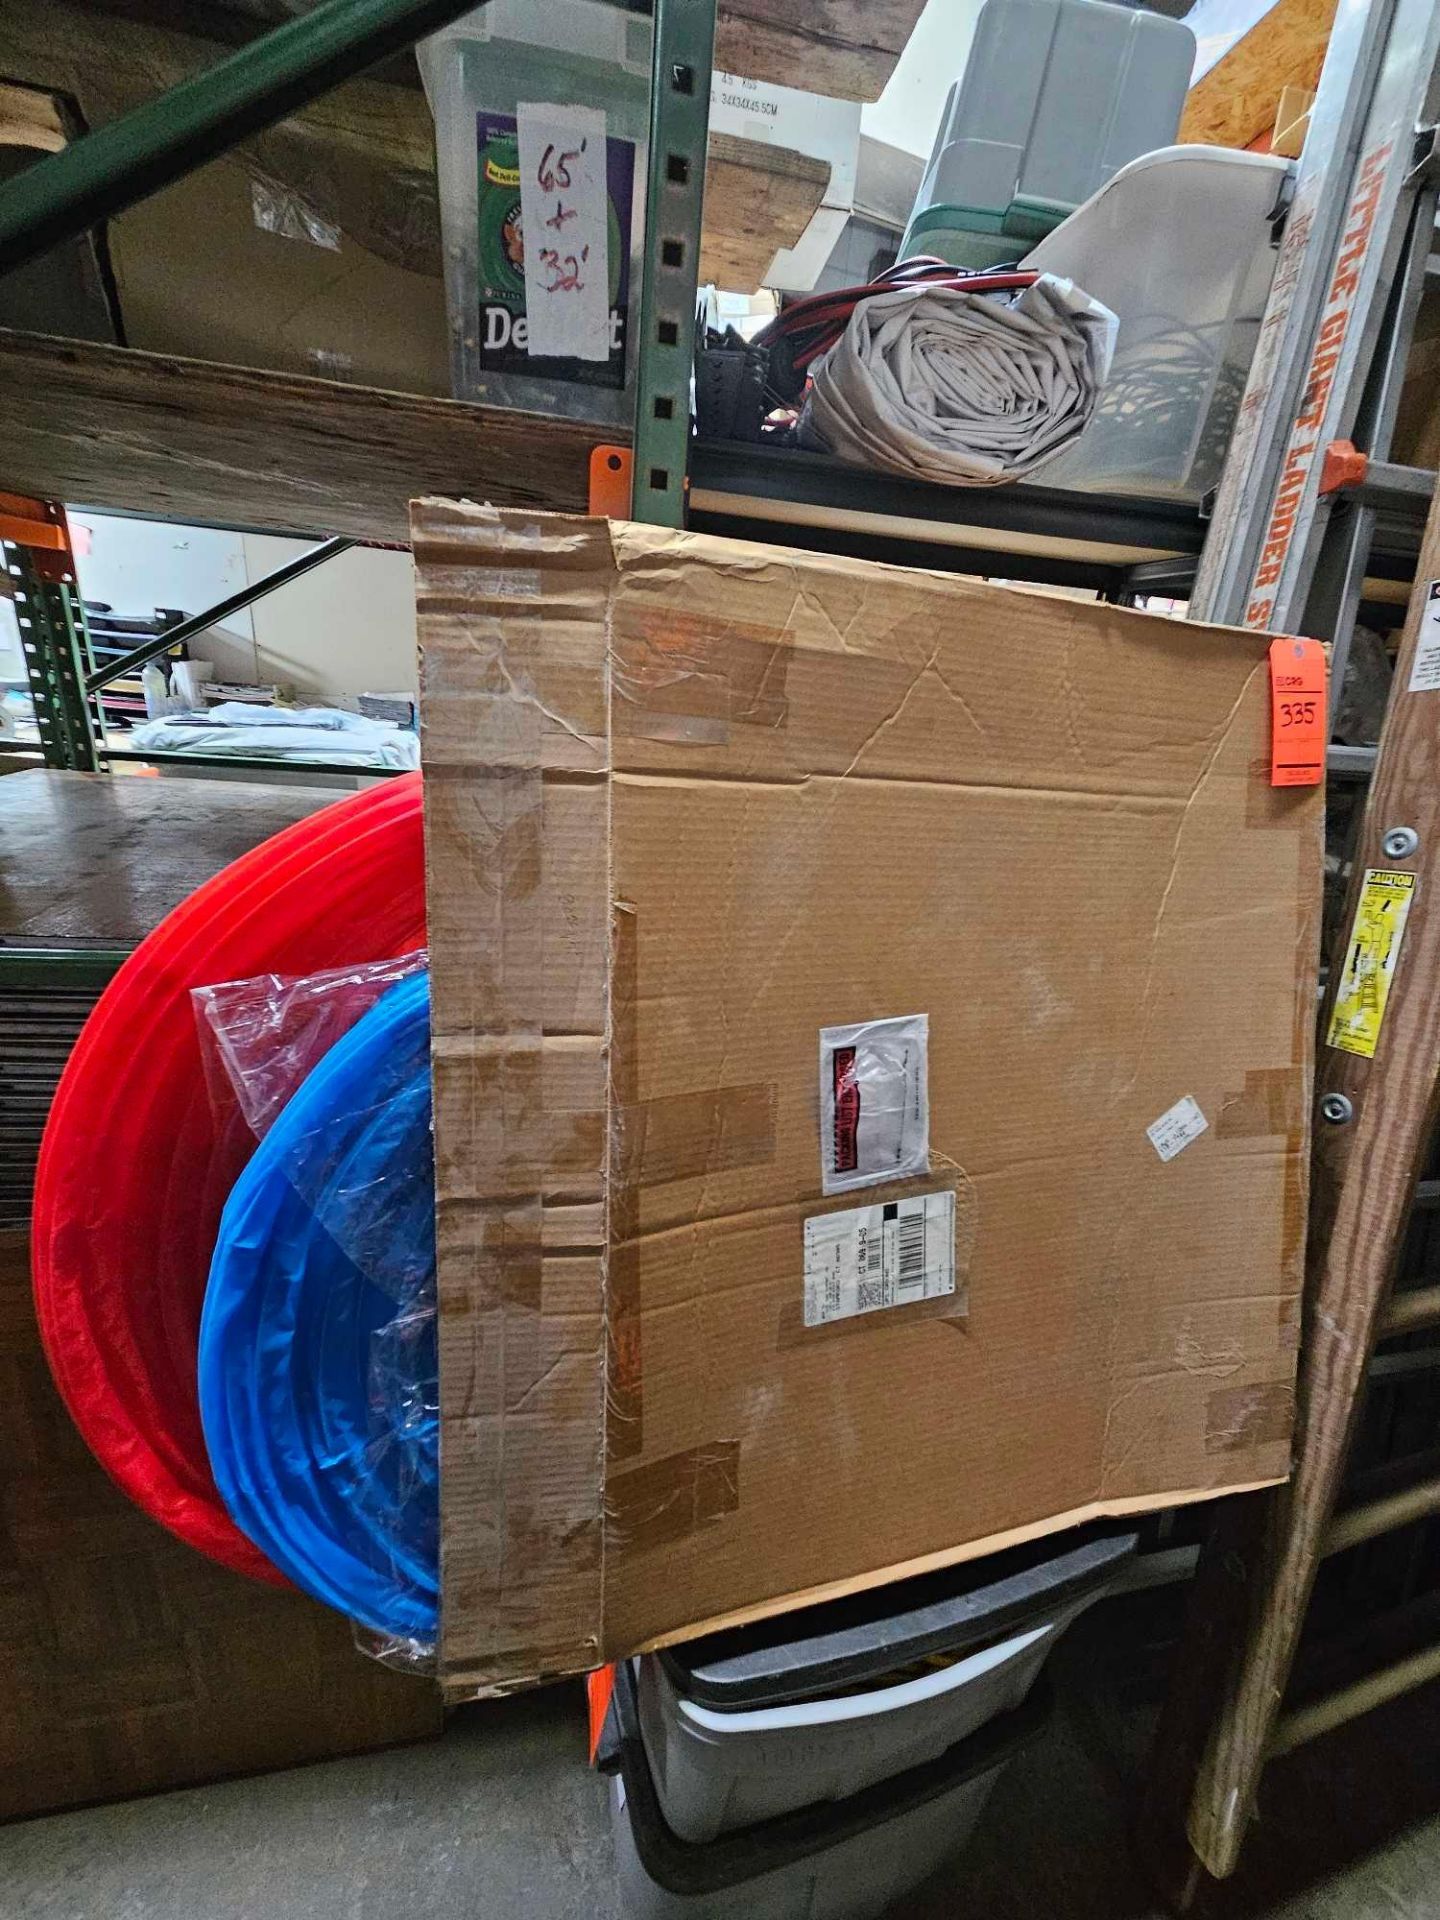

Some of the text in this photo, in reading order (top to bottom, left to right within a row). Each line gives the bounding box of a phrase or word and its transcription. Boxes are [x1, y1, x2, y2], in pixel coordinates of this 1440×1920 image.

[1295, 308, 1349, 431] GIANT
[1254, 440, 1315, 589] LADDER
[1280, 701, 1317, 728] 335
[1369, 871, 1413, 887] CAUTION
[841, 1107, 854, 1126] LIST
[839, 1127, 852, 1168] PACKING
